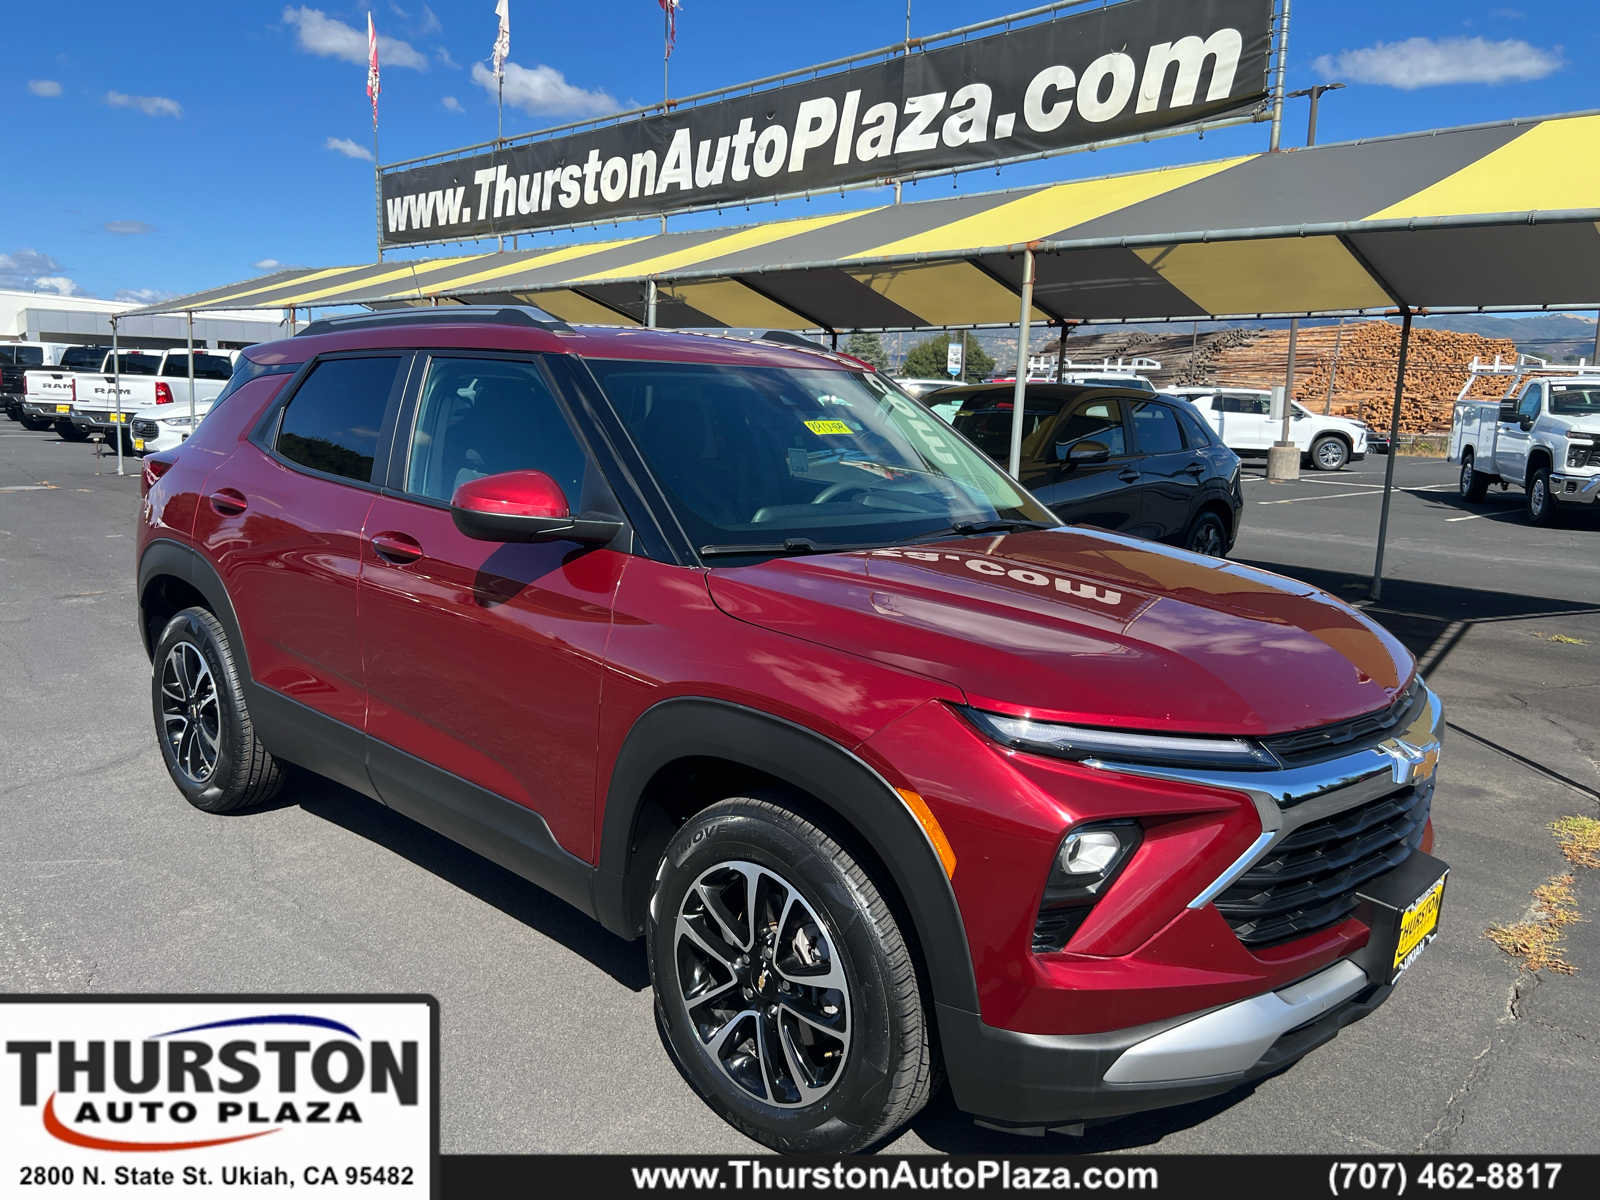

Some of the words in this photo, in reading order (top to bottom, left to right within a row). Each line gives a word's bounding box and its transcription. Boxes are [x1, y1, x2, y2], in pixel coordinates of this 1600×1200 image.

[386, 28, 1242, 233] www.ThurstonAutoPlaza.com
[42, 382, 73, 390] RAM
[94, 387, 131, 395] RAM
